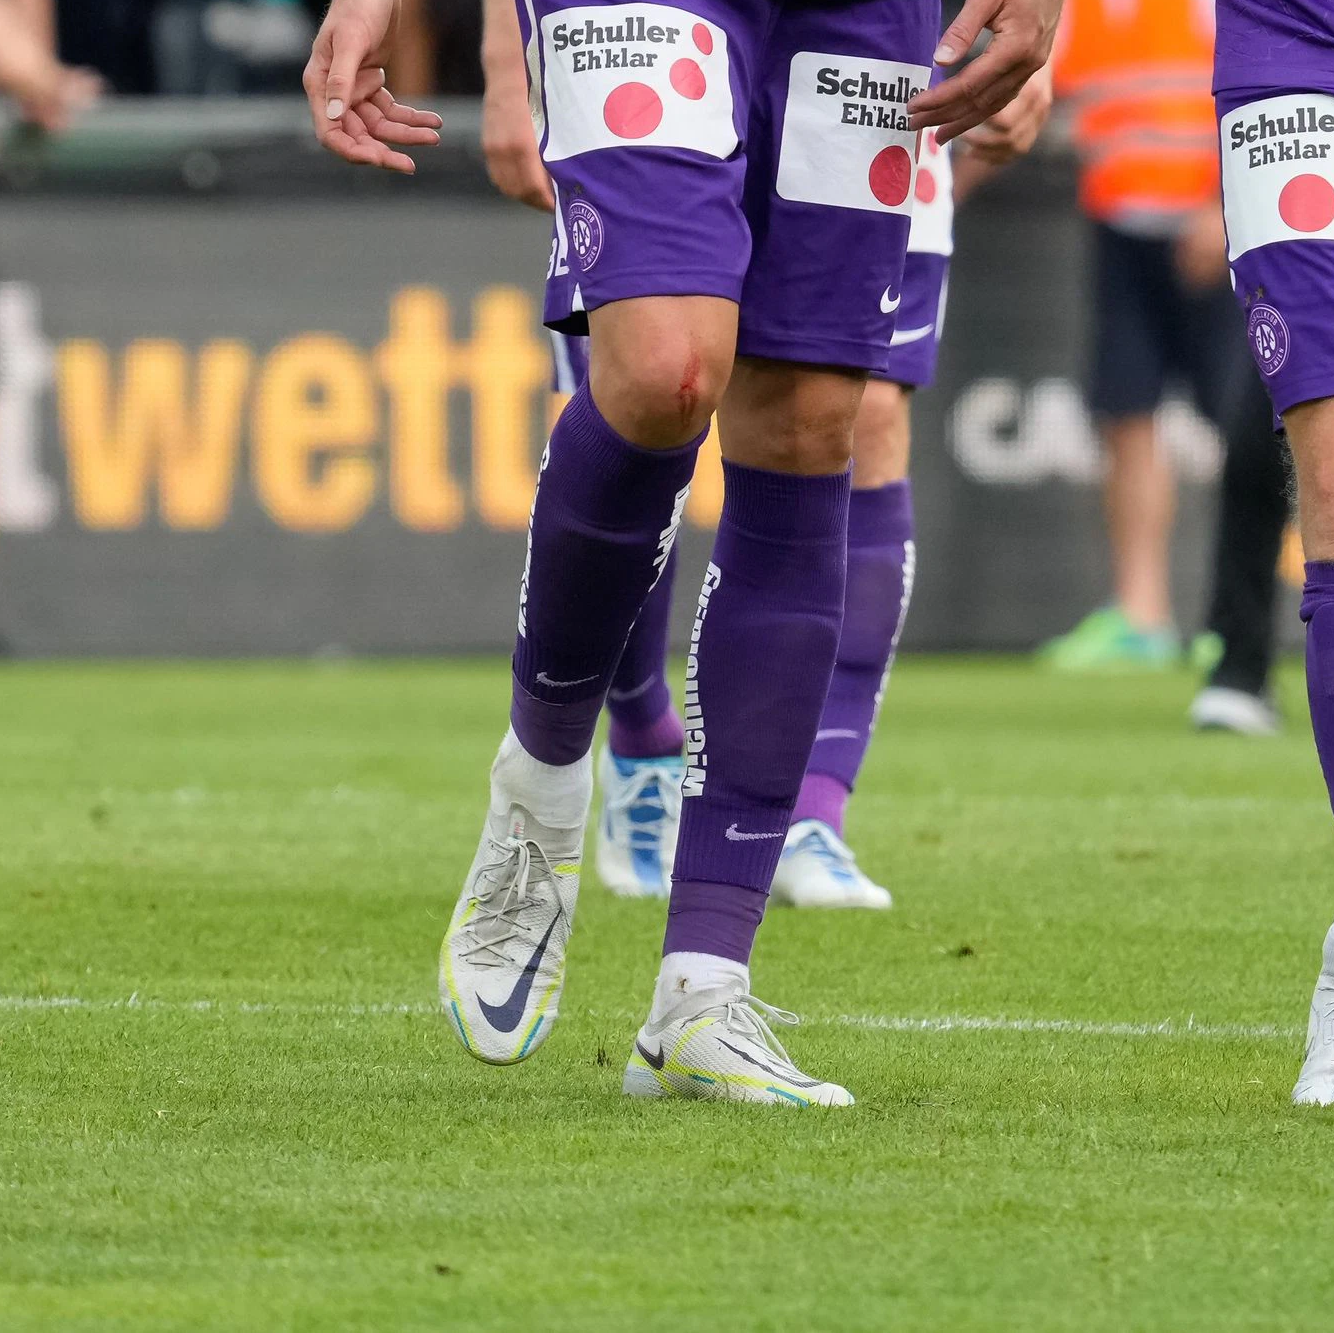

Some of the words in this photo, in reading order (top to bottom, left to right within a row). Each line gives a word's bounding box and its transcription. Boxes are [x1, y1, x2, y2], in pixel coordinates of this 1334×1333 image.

[553, 16, 680, 52] Schuller
[572, 47, 658, 73] Eh'klar
[1248, 139, 1331, 169] Eh'klar
